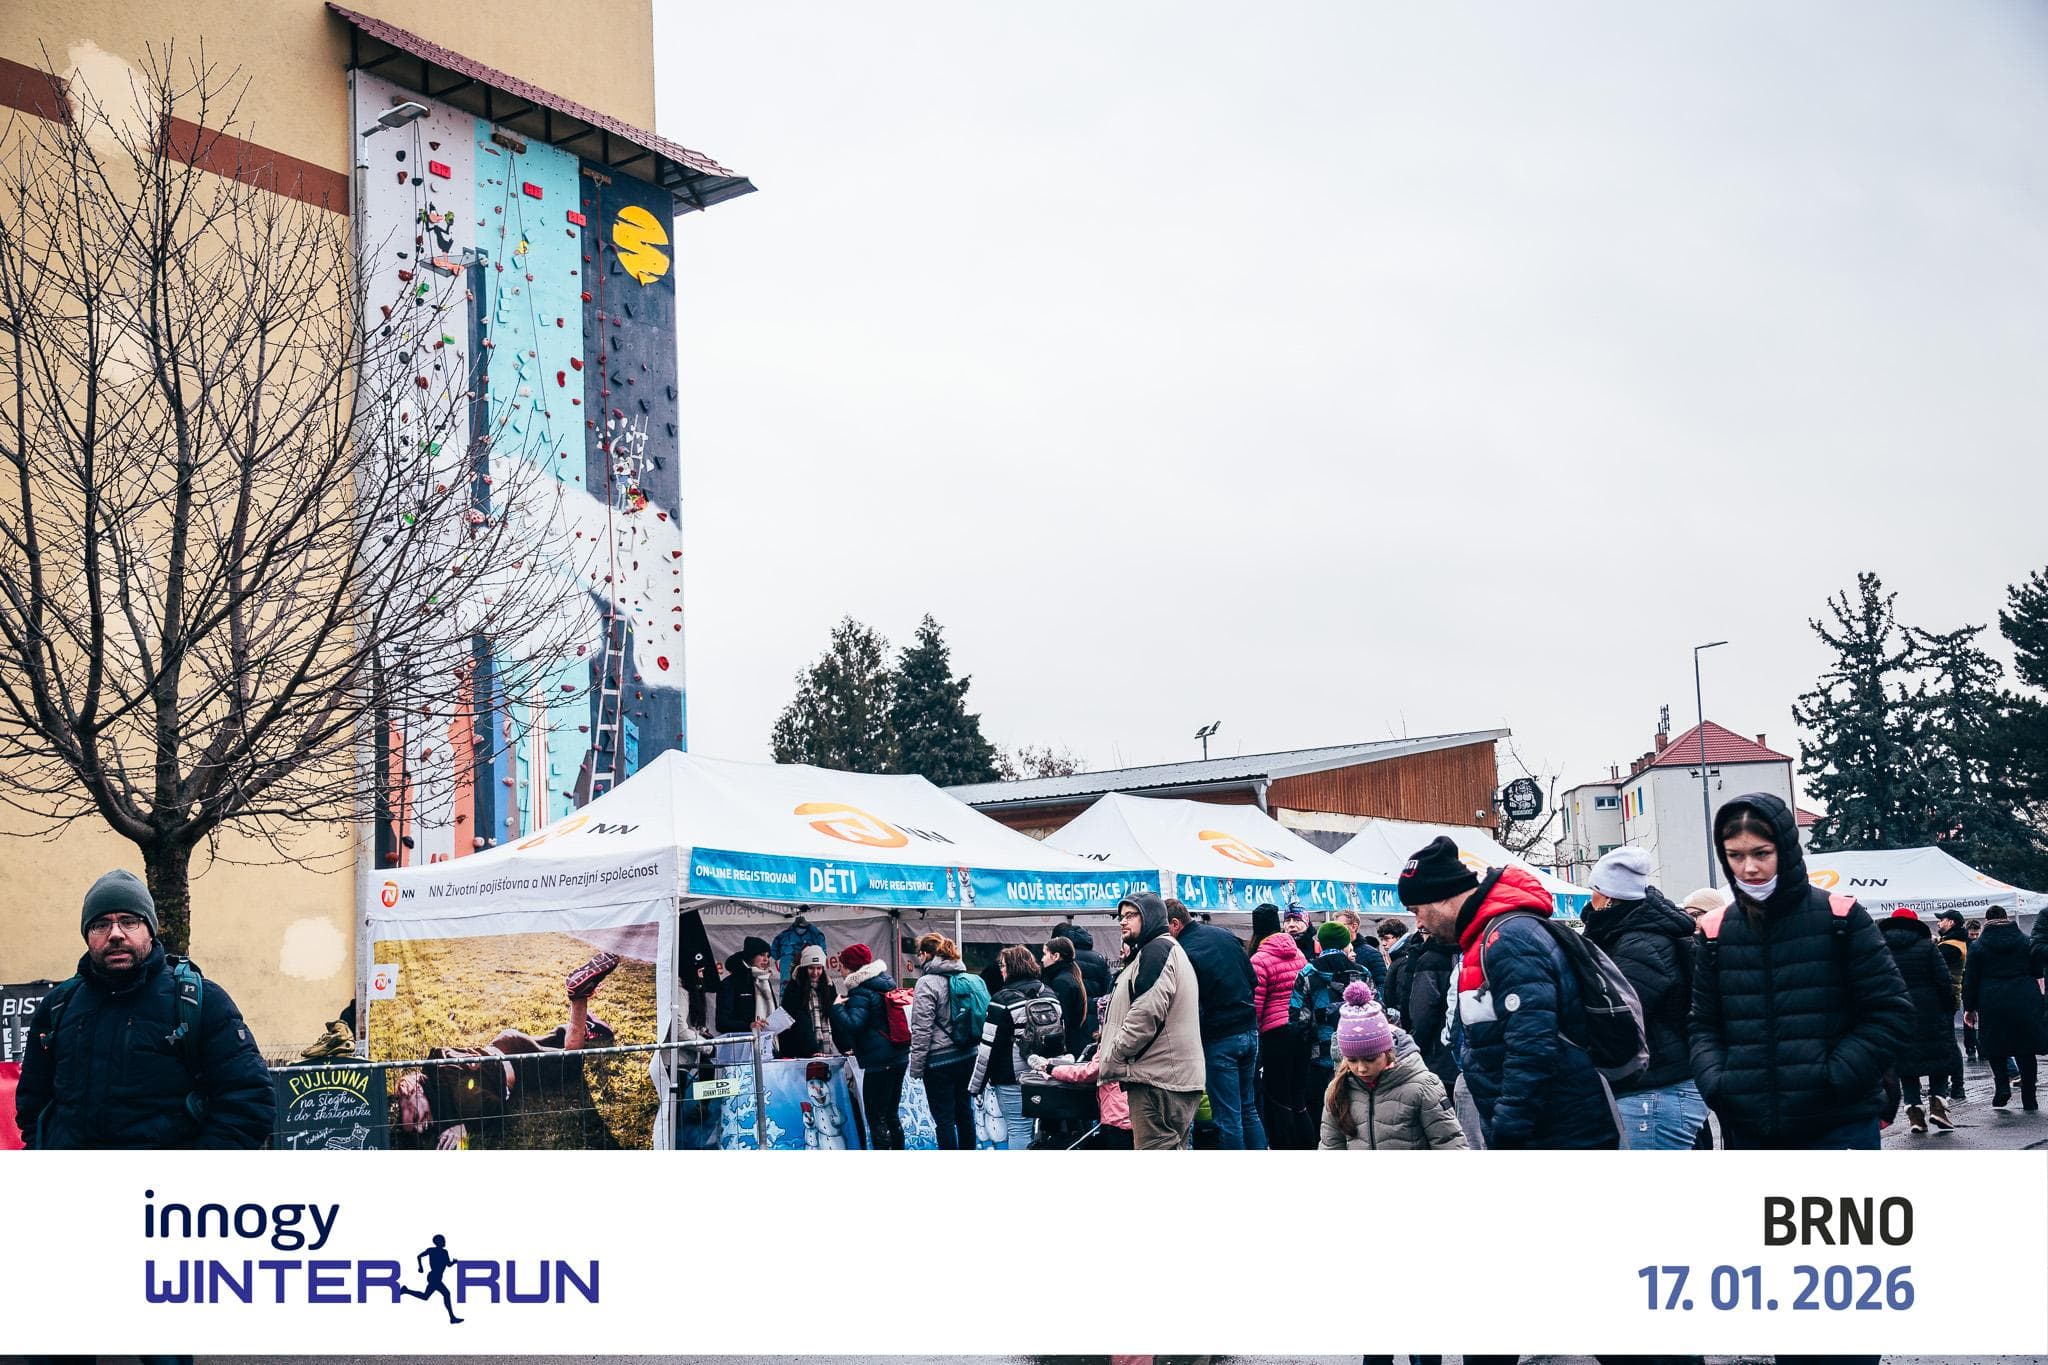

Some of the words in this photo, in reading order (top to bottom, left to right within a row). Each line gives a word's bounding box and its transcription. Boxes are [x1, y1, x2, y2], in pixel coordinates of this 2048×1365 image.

[428, 884, 444, 898] NN
[445, 880, 479, 897] Životní
[479, 875, 530, 895] pojišťovna
[532, 878, 538, 888] a
[540, 874, 557, 888] NN
[558, 869, 599, 887] Penzijní
[600, 862, 659, 884] společnost
[695, 864, 732, 880] ON-LINE
[809, 863, 857, 895] DĚTI
[869, 877, 889, 890] NOVÉ
[889, 879, 935, 893] REGISTRACE
[1006, 879, 1044, 901] NOVÉ
[1046, 881, 1121, 901] REGISTRACE
[1849, 878, 1888, 887] NN
[401, 889, 415, 899] NN
[1184, 875, 1208, 908] A-J
[1244, 884, 1252, 903] 8
[1255, 885, 1274, 904] KM
[1310, 880, 1337, 908] K-Q
[1370, 889, 1378, 905] 8
[1379, 888, 1394, 907] KM
[1880, 903, 1895, 911] NN
[1936, 898, 1990, 910] společnost
[300, 1099, 316, 1108] na
[294, 1108, 311, 1121] do
